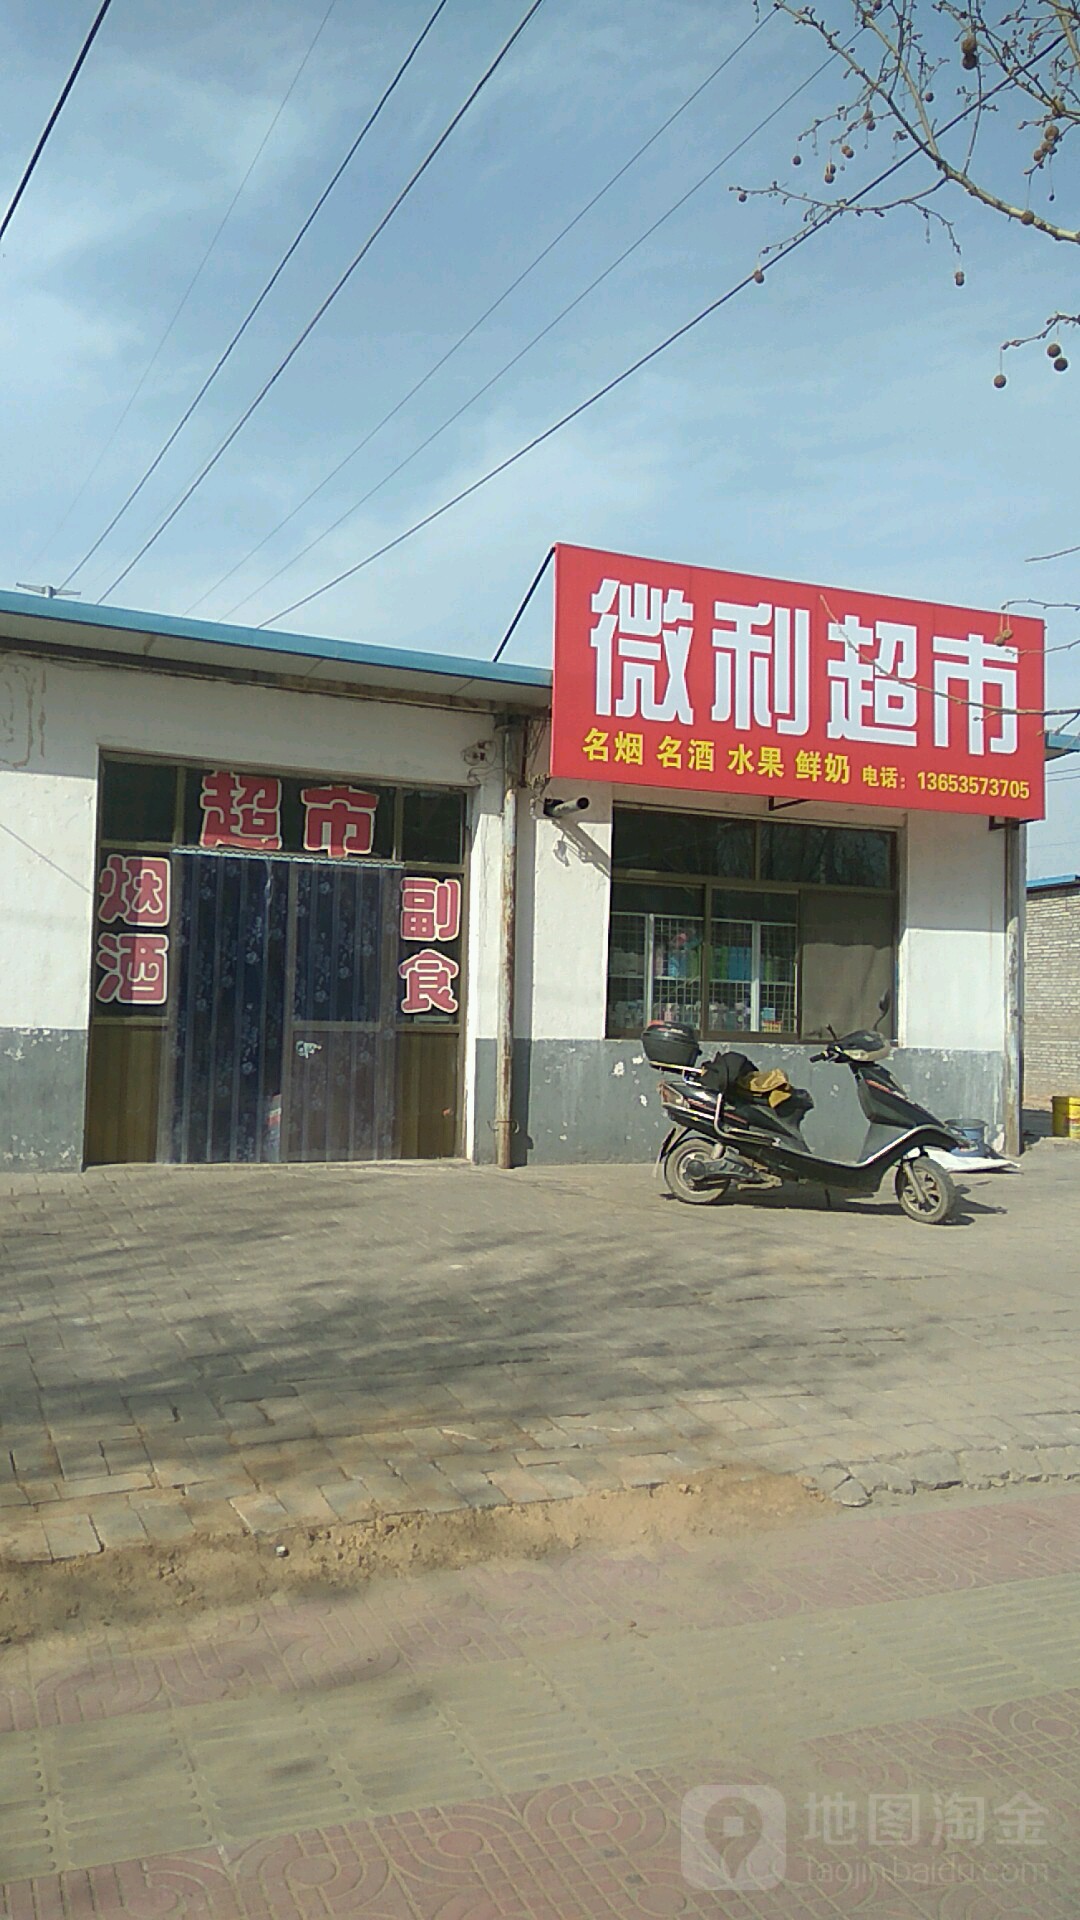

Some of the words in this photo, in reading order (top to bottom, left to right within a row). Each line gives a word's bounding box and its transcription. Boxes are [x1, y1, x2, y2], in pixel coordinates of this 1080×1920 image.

[590, 578, 1018, 756] 微利超市
[200, 770, 379, 858] 超市
[582, 727, 644, 766] 名烟
[657, 735, 715, 772] 名酒
[728, 743, 785, 779] 水果
[795, 750, 850, 784] 鲜奶
[917, 771, 1030, 799] 13653573705
[96, 853, 171, 1005] 烟酒
[398, 876, 461, 1014] 副食
